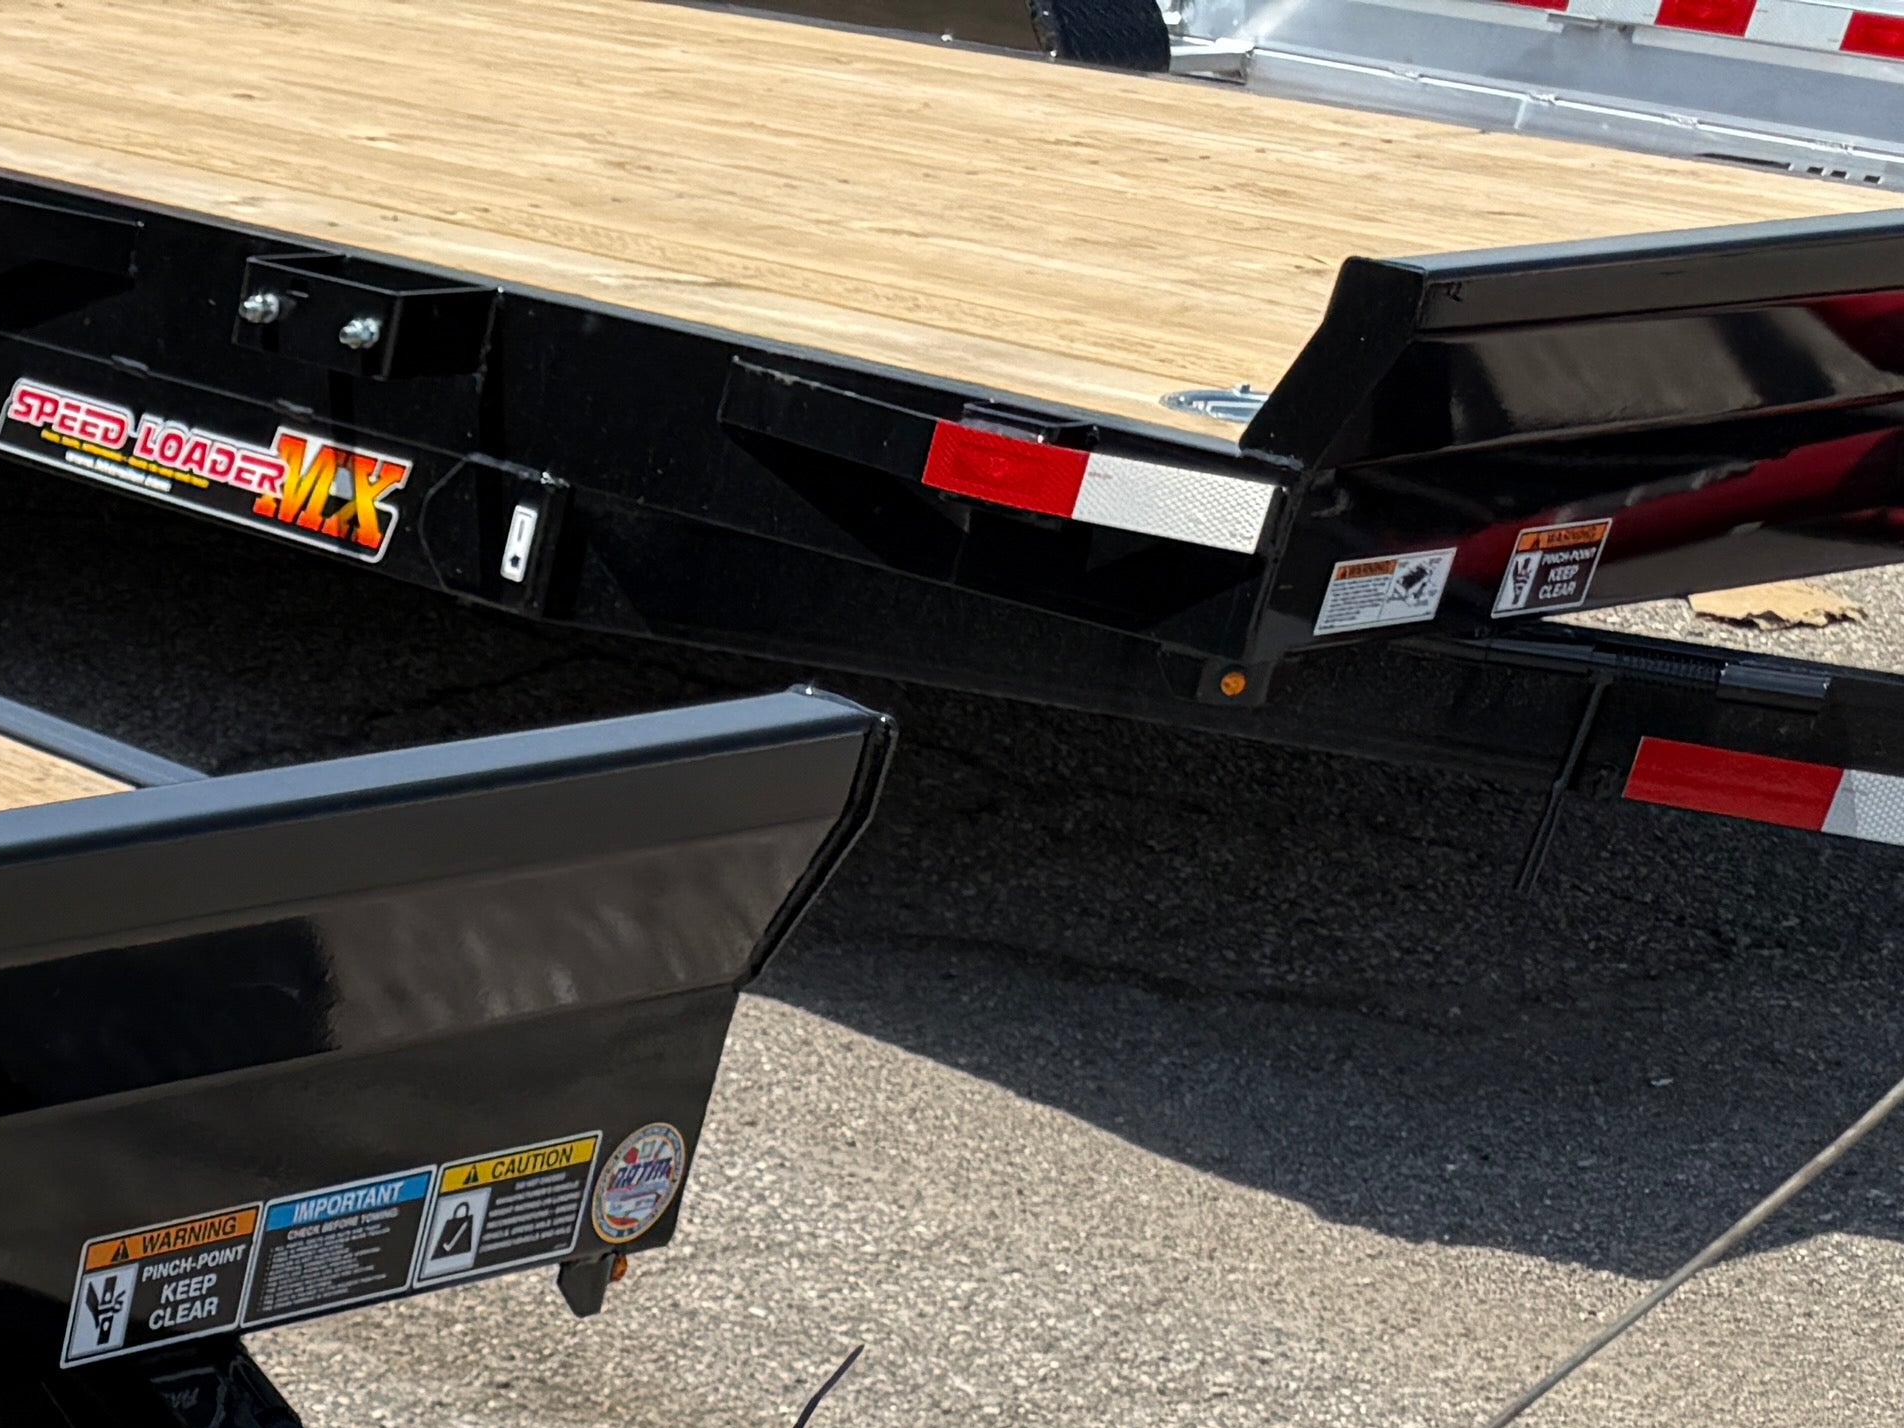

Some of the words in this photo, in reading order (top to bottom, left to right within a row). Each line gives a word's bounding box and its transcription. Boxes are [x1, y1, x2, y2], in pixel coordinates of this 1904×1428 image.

[8, 384, 128, 449] SPEED
[133, 414, 289, 496] LOADER
[1537, 581, 1576, 599] CLEAR
[1547, 564, 1579, 582] KEEP
[491, 1145, 573, 1179] CAUTION
[293, 1181, 404, 1223] IMPORTANT
[142, 1216, 236, 1254] WARNING
[142, 1244, 245, 1282] PINCH-POINT
[161, 1272, 216, 1303] KEEP
[148, 1296, 218, 1330] CLEAR
